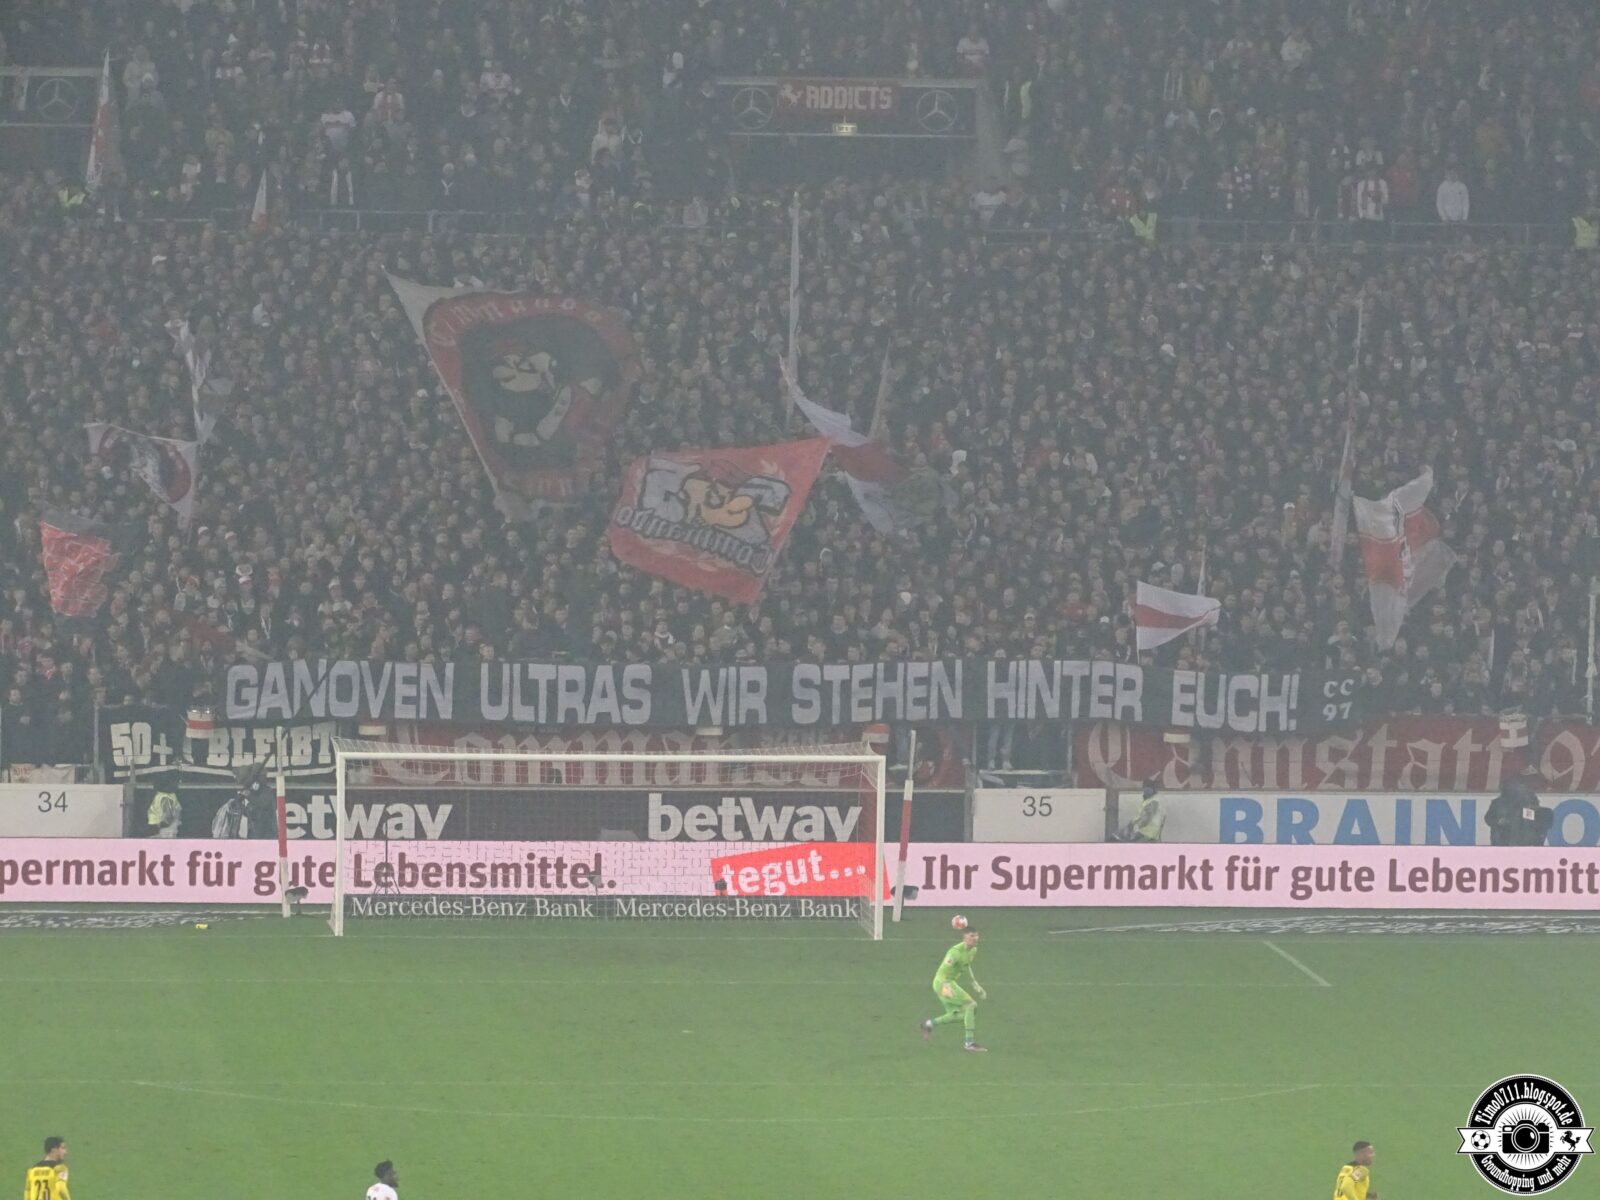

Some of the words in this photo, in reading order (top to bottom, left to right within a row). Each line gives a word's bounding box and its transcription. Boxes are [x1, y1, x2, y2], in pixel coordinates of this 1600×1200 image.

[806, 85, 892, 110] ADDICTS
[226, 658, 454, 721] GANOVEN
[480, 663, 652, 724] ULTRAS
[682, 666, 768, 726] WIR
[791, 659, 963, 724] STEHEN
[986, 659, 1143, 722] HINTER
[1171, 669, 1299, 732] EUCH!
[1323, 679, 1354, 698] CC
[1322, 701, 1352, 721] 97
[1540, 730, 1600, 792] 9
[37, 791, 69, 813] 34
[1022, 795, 1053, 818] 35
[239, 795, 453, 840] etway
[648, 792, 863, 842] betway
[187, 850, 242, 887] für
[253, 857, 335, 894] gute
[922, 854, 979, 891] Ihr
[990, 854, 1214, 899] Supermarkt
[1225, 855, 1280, 892] für
[1290, 861, 1375, 900] gute
[1388, 857, 1600, 895] Lebensmitt
[352, 895, 526, 918] Mercedes-Benz
[536, 898, 594, 918] Bank
[616, 896, 791, 918] Mercedes-Benz
[800, 898, 859, 919] Bank
